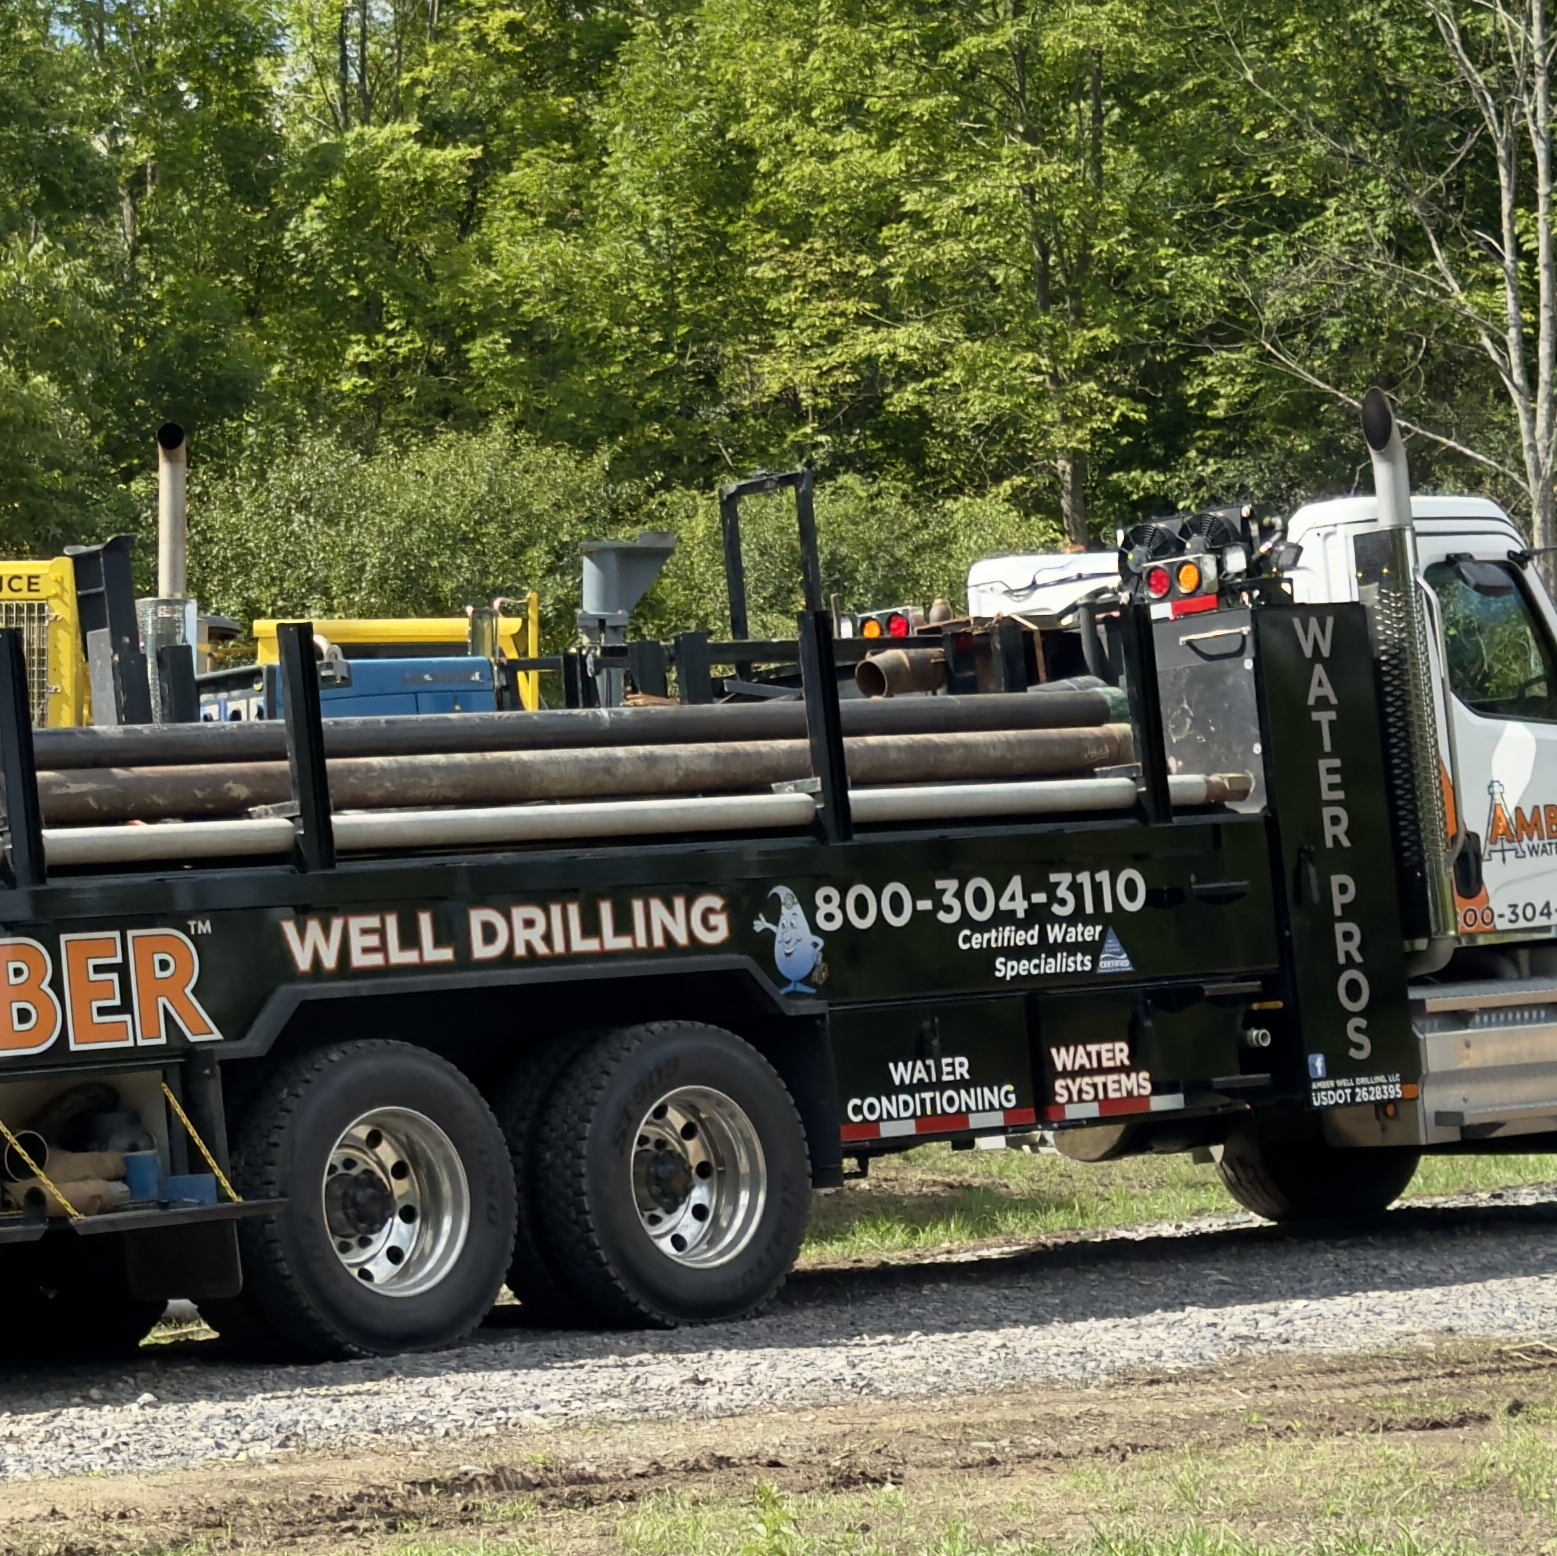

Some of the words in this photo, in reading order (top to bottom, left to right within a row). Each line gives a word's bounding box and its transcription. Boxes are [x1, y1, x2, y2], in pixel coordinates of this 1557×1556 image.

[1291, 615, 1354, 849] WATER
[1331, 876, 1372, 1061] PROS
[815, 868, 1147, 934] 800-304-3110
[281, 912, 454, 975] WELL
[467, 893, 730, 964] DRILLING
[957, 922, 1039, 951] Certified
[1046, 922, 1102, 945] Water
[994, 951, 1093, 981] Specialists
[1051, 1041, 1130, 1072] WATER
[1053, 1071, 1152, 1105] SYSTEMS
[1312, 1079, 1335, 1090] AMBER
[1336, 1078, 1355, 1088] WELL
[1388, 1072, 1401, 1083] LLC
[1312, 1088, 1352, 1107] USDOT
[1355, 1083, 1403, 1102] 2628395
[846, 1083, 1017, 1124] CONDITIONING
